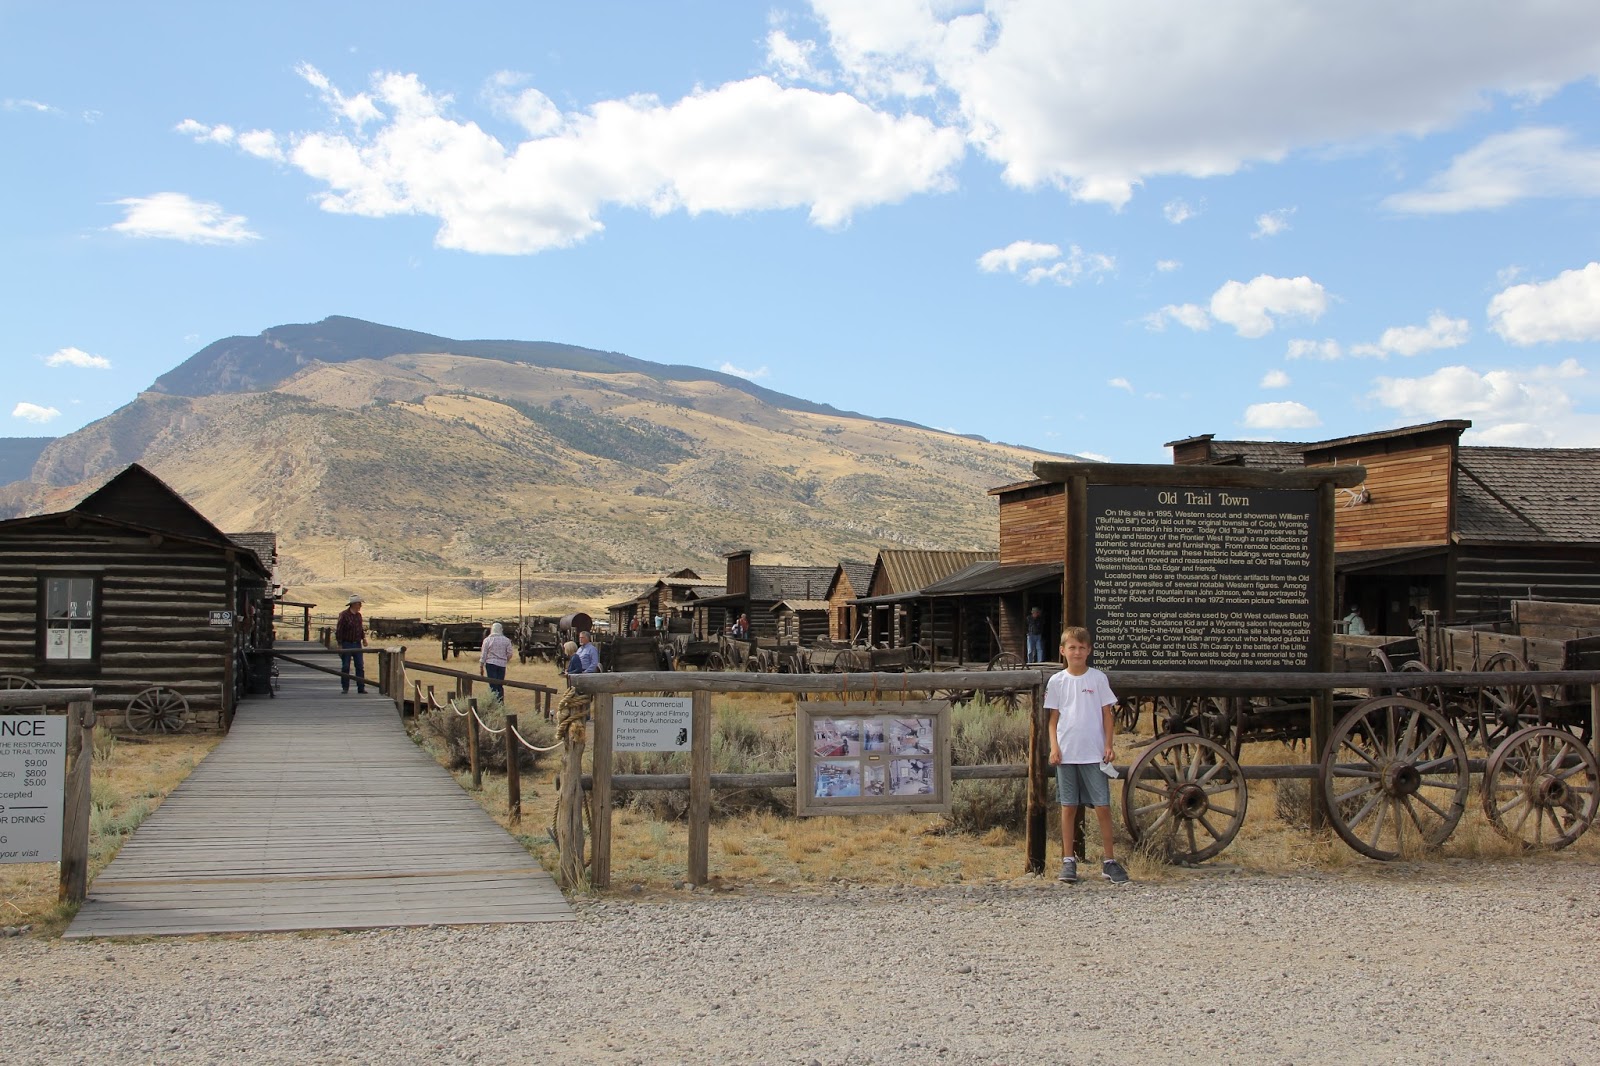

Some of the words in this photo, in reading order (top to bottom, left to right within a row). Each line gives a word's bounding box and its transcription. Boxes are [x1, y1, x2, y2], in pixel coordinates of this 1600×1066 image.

[1158, 492, 1177, 504] Old
[1184, 492, 1211, 505] Trail
[1218, 493, 1249, 506] Town
[1156, 510, 1173, 518] 1895,
[1198, 526, 1217, 535] Today
[1182, 541, 1221, 550] furnishings.
[1096, 547, 1130, 556] Wyoming
[1230, 549, 1260, 558] buildings
[1281, 550, 1309, 559] carefully
[1302, 558, 1309, 566] by
[1129, 580, 1164, 588] gravesites
[1256, 581, 1279, 590] figures.
[1283, 582, 1307, 590] Among
[1251, 596, 1274, 605] picture
[1152, 610, 1177, 619] original
[1220, 611, 1228, 620] by
[1260, 634, 1282, 643] helped
[1283, 635, 1301, 643] guide
[1093, 657, 1119, 666] uniquely
[1152, 657, 1186, 666] experience
[1209, 658, 1241, 666] throughout
